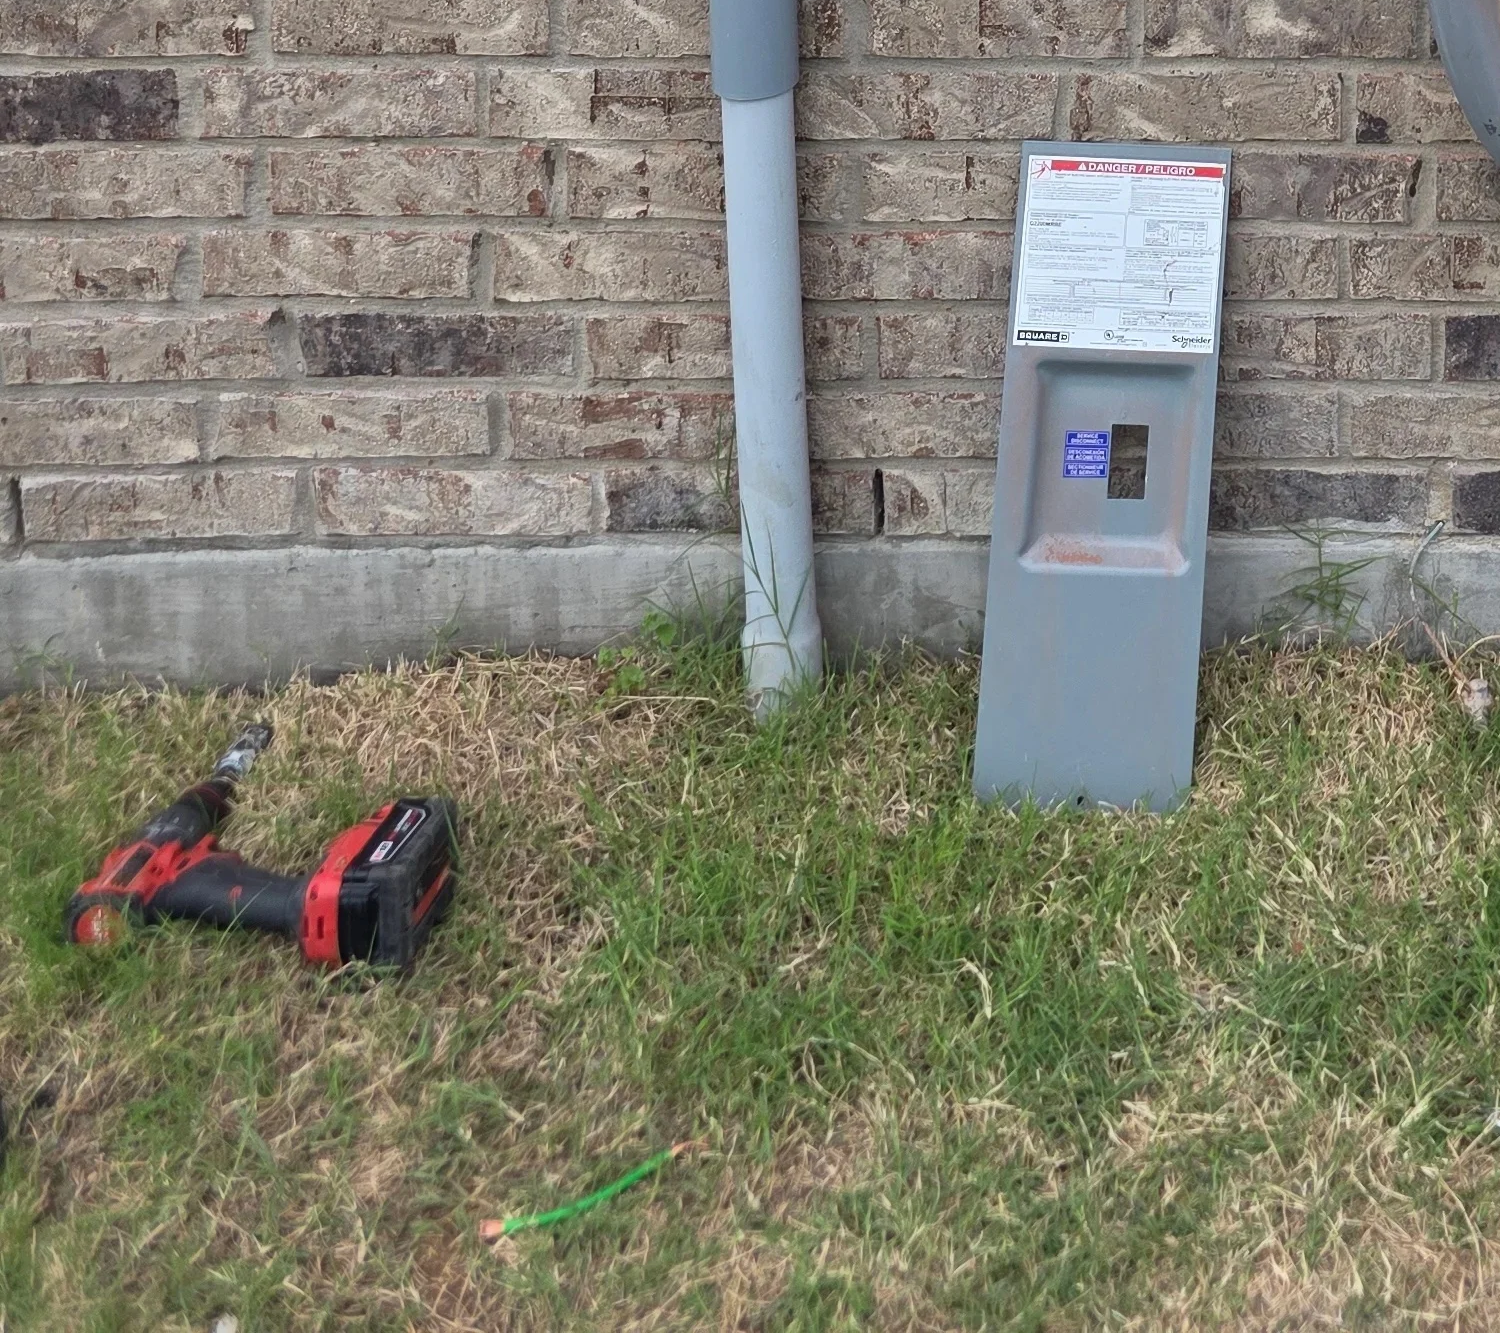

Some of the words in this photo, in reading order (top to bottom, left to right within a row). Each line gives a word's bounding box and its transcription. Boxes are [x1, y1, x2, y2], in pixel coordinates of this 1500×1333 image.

[1089, 162, 1136, 173] DANGER
[1146, 165, 1196, 176] PELIGRO
[1172, 335, 1212, 348] Schneider
